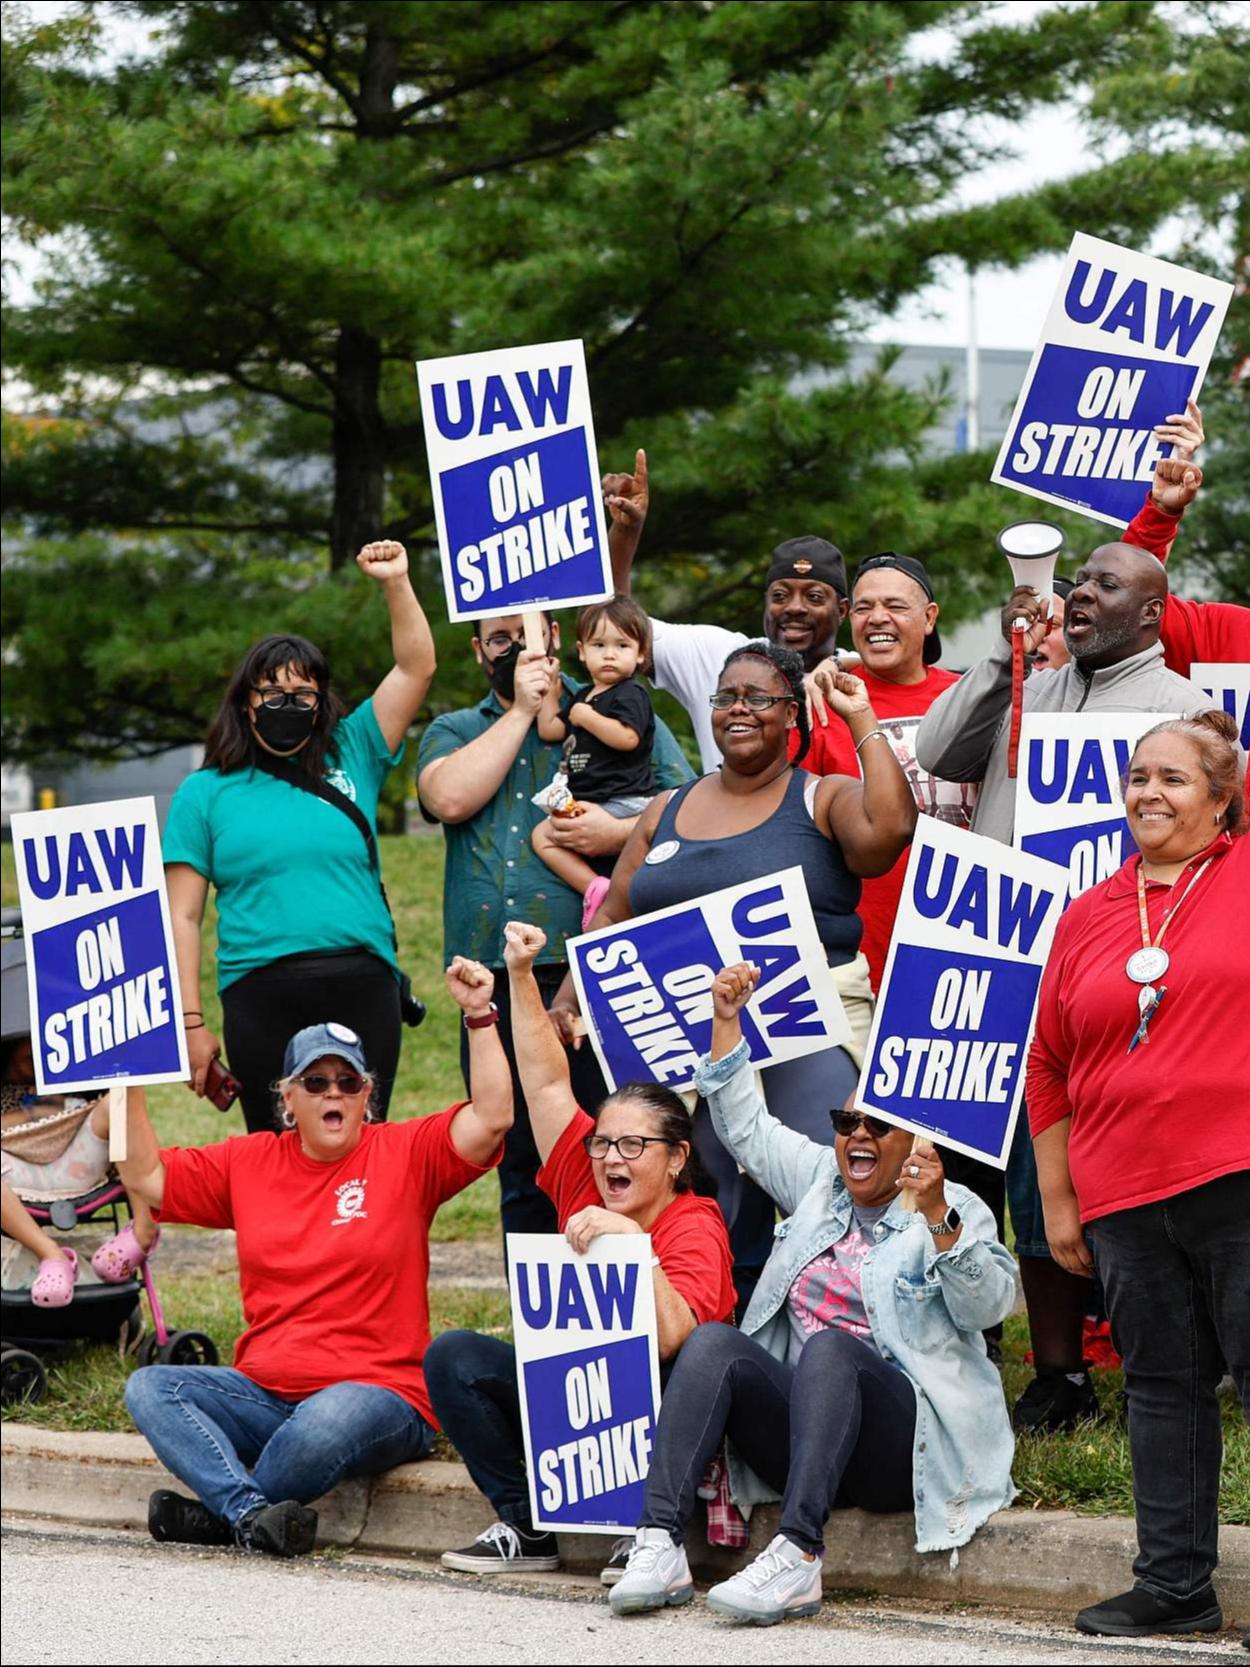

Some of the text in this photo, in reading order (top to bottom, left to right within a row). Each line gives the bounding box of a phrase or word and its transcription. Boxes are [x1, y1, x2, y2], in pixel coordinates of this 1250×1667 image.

[1064, 259, 1214, 358] UAW
[431, 365, 573, 440] UAW
[1077, 366, 1145, 421] ON
[488, 452, 542, 523] ON
[1012, 421, 1163, 482] STRIKE
[458, 497, 594, 602] STRIKE
[24, 824, 146, 899] UAW
[1069, 830, 1122, 899] ON
[912, 844, 1053, 955] UAW
[75, 921, 126, 990] ON
[731, 884, 828, 1038] UAW
[45, 967, 170, 1074] STRIKE
[585, 939, 702, 1084] STRIKE
[662, 963, 716, 1026] ON
[929, 967, 992, 1032] ON
[873, 1035, 1018, 1104] STRIKE
[516, 1262, 639, 1331] UAW
[565, 1357, 612, 1430] ON
[538, 1416, 652, 1513] STRIKE
